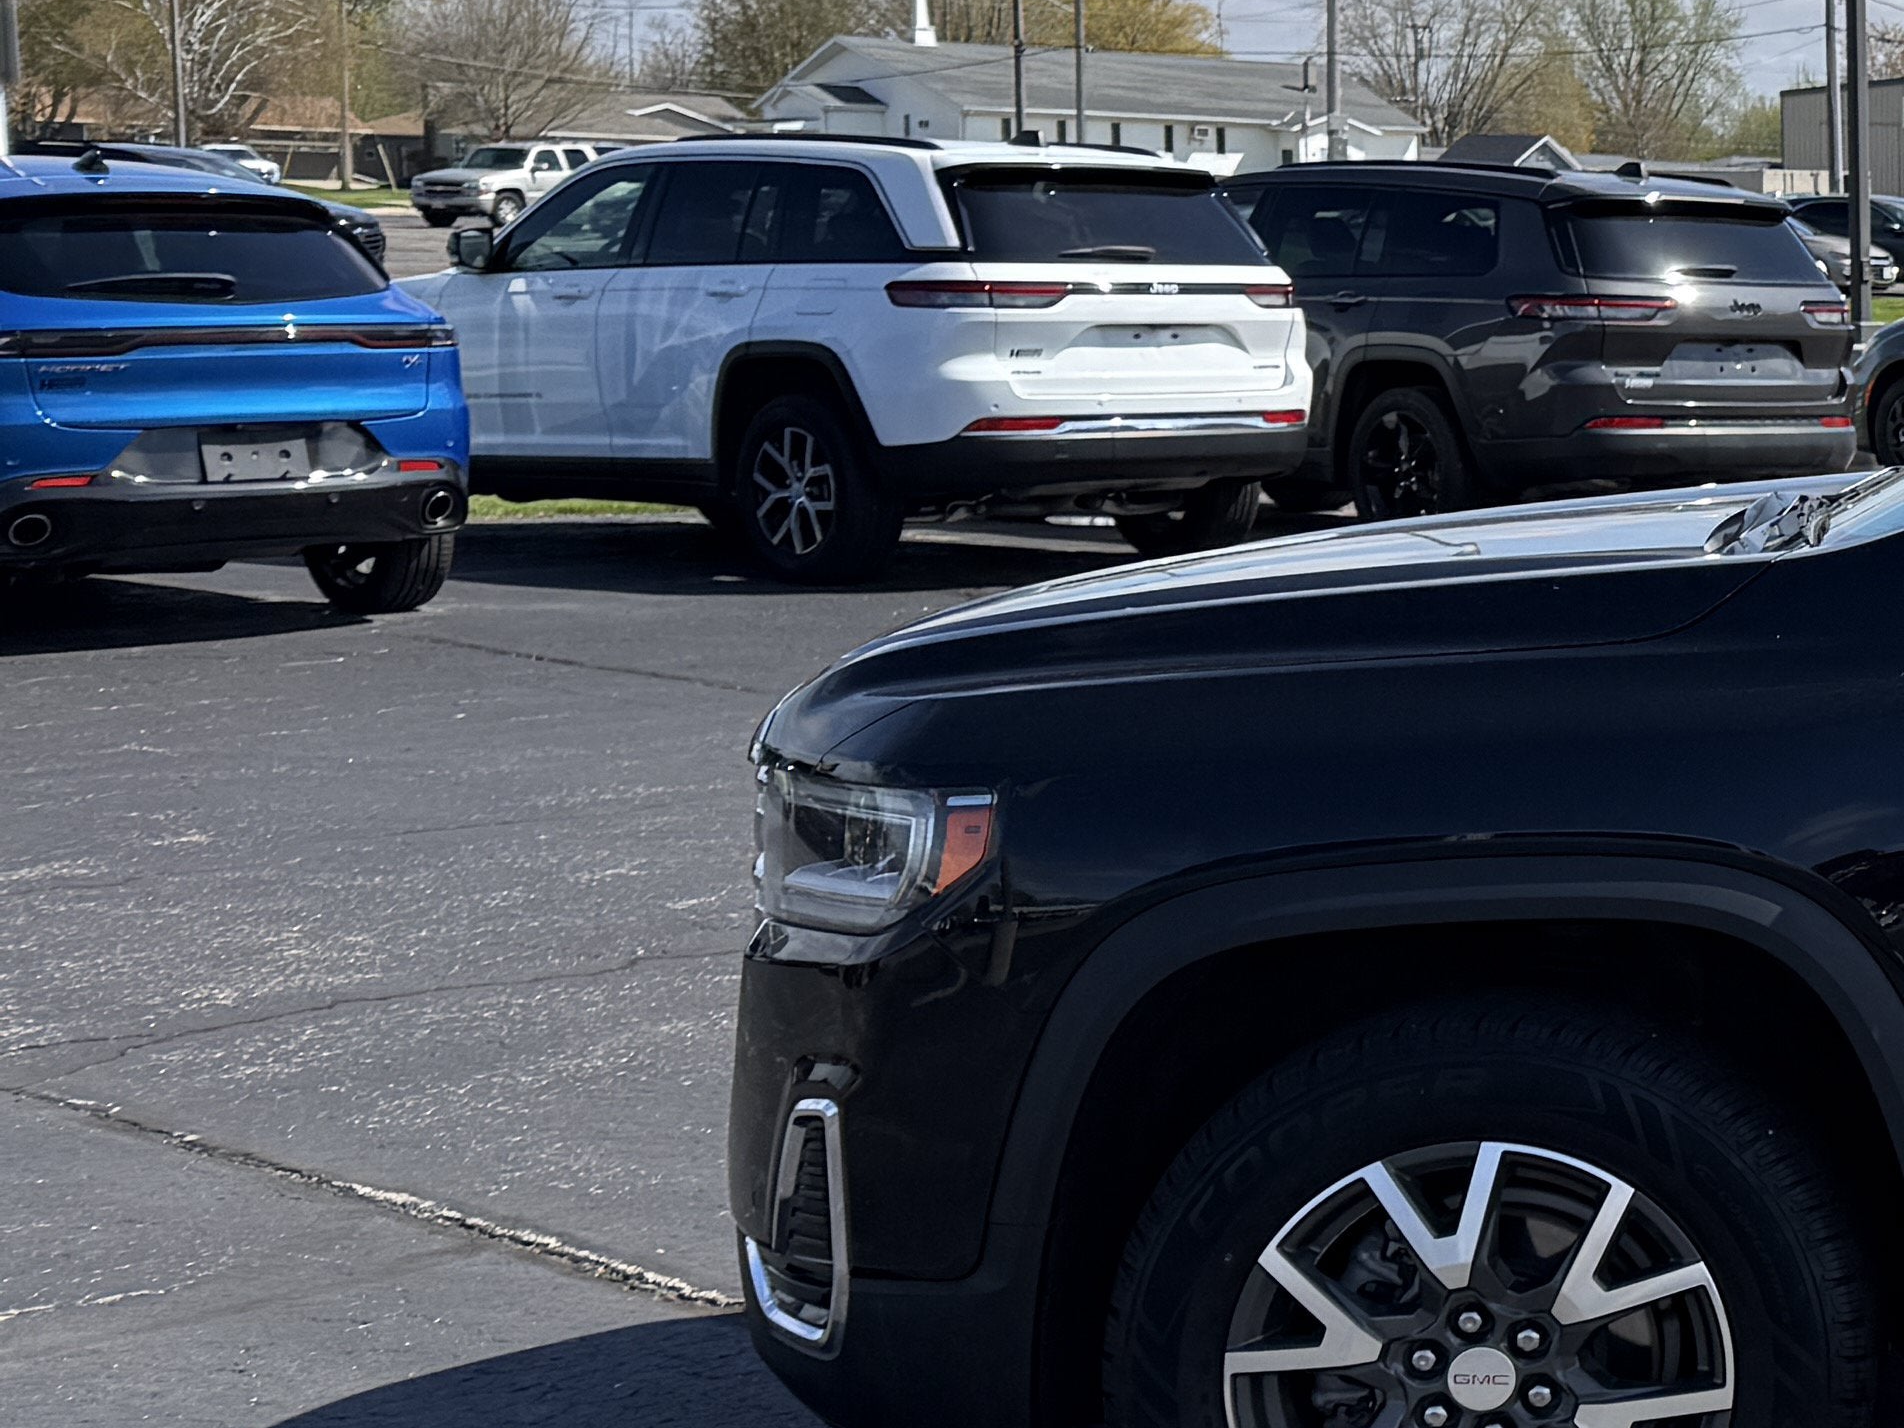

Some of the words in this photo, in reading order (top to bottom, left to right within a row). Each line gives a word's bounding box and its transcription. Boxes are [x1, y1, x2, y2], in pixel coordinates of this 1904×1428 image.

[1150, 281, 1179, 294] Jeep
[1729, 299, 1763, 316] Jeep
[1453, 1374, 1510, 1386] GMC
